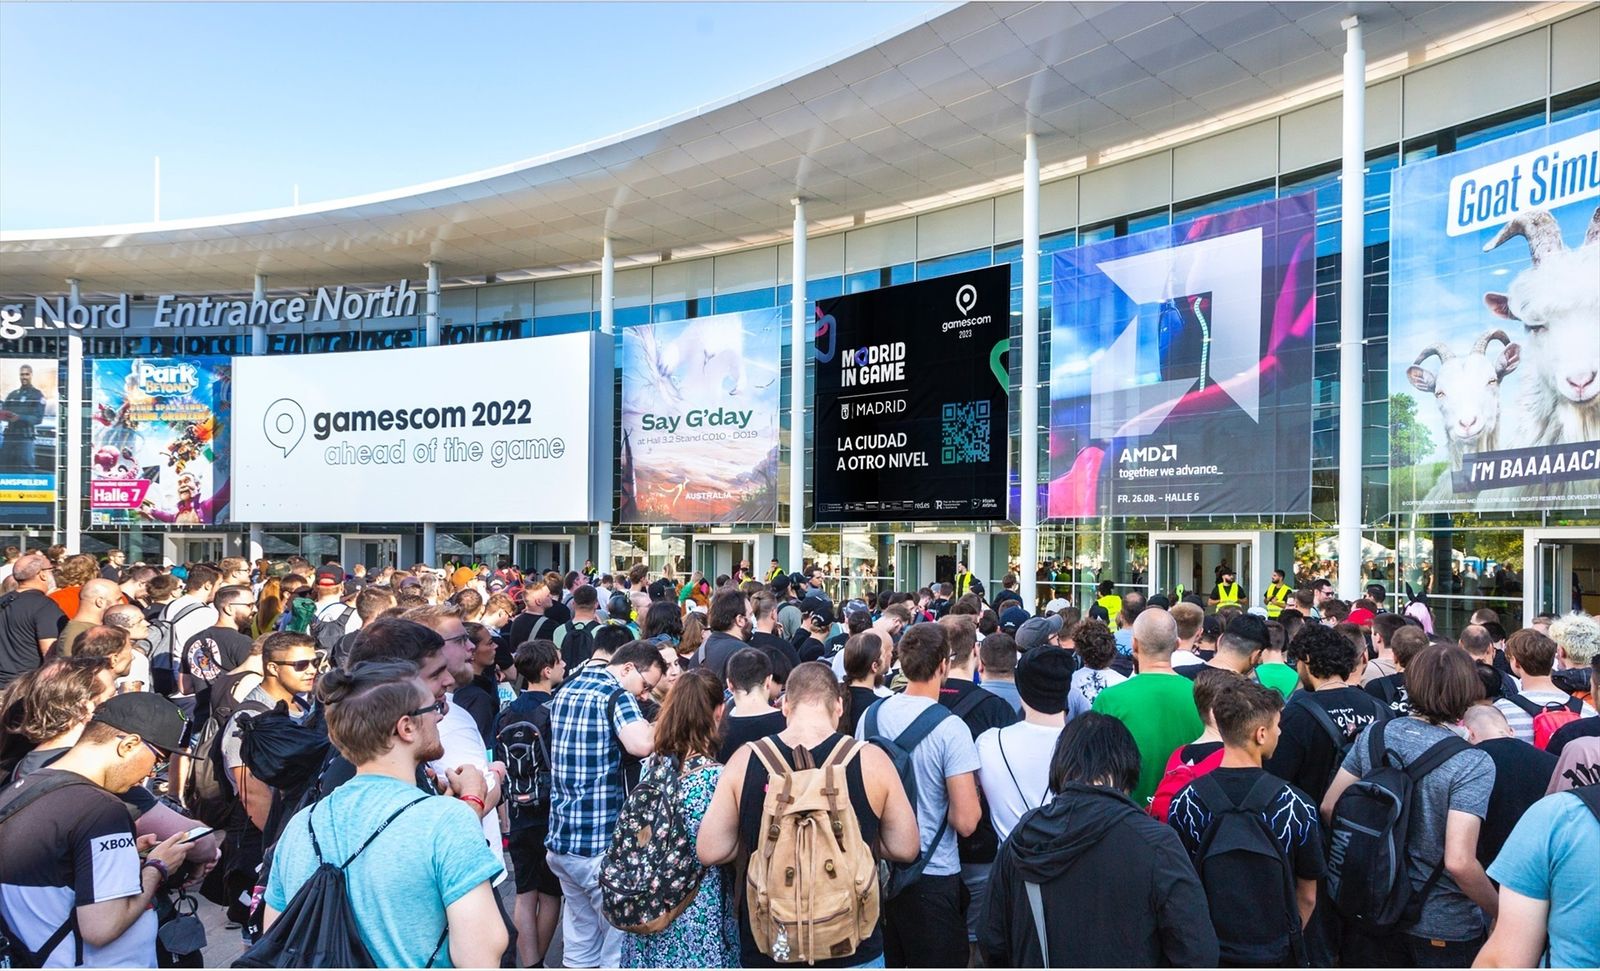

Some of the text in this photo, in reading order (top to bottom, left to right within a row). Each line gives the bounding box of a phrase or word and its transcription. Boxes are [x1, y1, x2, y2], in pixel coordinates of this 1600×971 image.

[1458, 164, 1522, 227] Goat
[35, 293, 129, 330] Nord
[153, 294, 306, 327] Entrance
[312, 279, 418, 323] North
[942, 314, 991, 333] gamescom
[959, 329, 972, 339] 2023
[140, 365, 198, 387] Park
[841, 362, 905, 387] IN GAME
[146, 382, 191, 393] BEYOND
[856, 400, 907, 417] MADRID
[313, 399, 532, 441] gamescom 2022
[641, 413, 681, 434] Say
[675, 434, 700, 443] Stand
[837, 432, 907, 452] LA CIUDAD
[324, 436, 565, 468] ahead of the game
[836, 451, 929, 471] A OTRO NIVEL
[1119, 446, 1161, 463] AMD
[1118, 466, 1158, 480] together
[1160, 467, 1175, 476] we
[1470, 460, 1496, 482] I'M
[94, 488, 141, 502] Halle 7
[685, 492, 732, 501] AUSTRALIA
[1117, 494, 1131, 503] FR.
[1132, 494, 1157, 503] 26.08.
[1165, 492, 1192, 502] HALLE
[1194, 492, 1200, 501] 6
[100, 837, 134, 852] XBOX
[1327, 829, 1353, 877] PUMA
